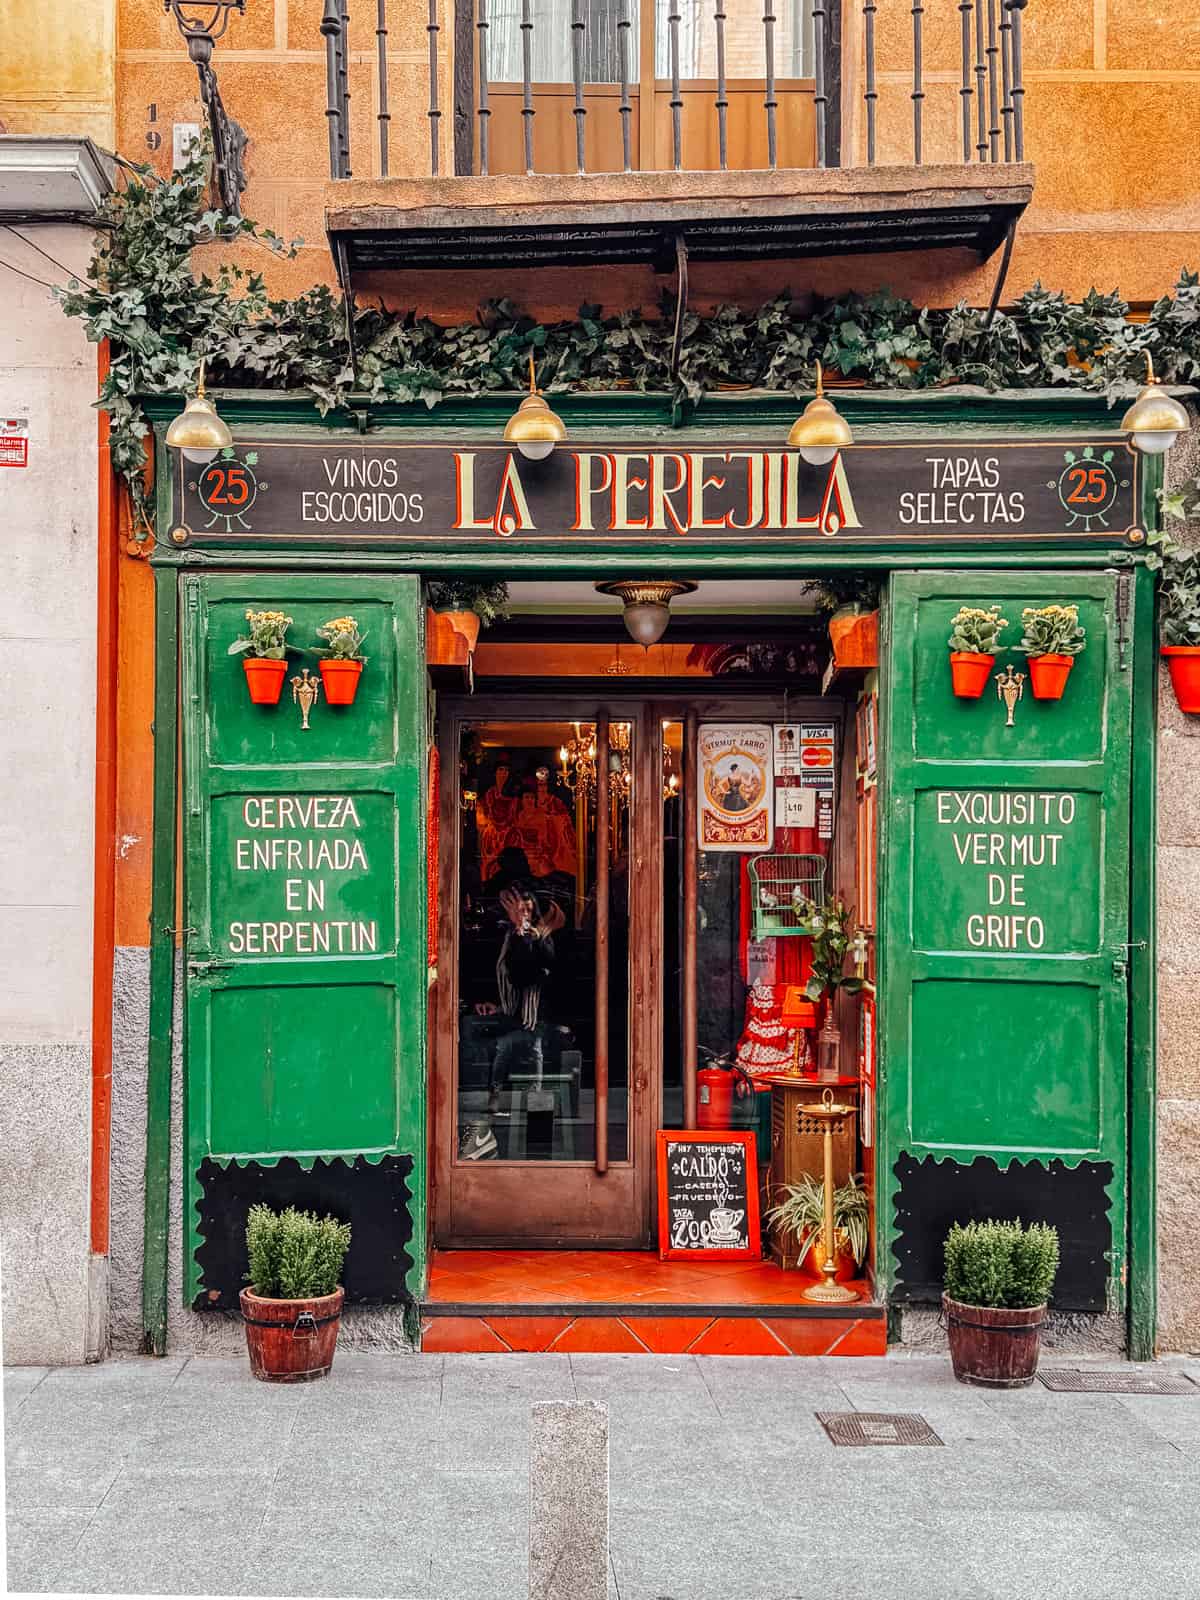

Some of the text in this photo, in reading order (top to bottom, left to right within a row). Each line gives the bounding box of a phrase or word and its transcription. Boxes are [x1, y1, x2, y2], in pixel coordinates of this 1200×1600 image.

[207, 469, 249, 505] 25
[323, 458, 398, 488] VINOS
[926, 457, 1000, 489] TAPAS
[1066, 468, 1108, 504] 25
[302, 491, 424, 523] ESCOGIDOS
[451, 451, 865, 537] LA PEREJILA
[899, 491, 1025, 524] SELECTAS
[739, 739, 765, 750] ZARRO
[806, 729, 829, 738] VISA
[243, 797, 361, 829] CERVEZA
[937, 792, 1076, 825] EXQUISITO
[236, 839, 368, 870] ENFRIADA
[952, 833, 1064, 866] VERMUT
[286, 879, 325, 911] EN
[987, 874, 1026, 907] DE
[229, 921, 377, 953] SERPENTIN
[966, 914, 1045, 949] GRIFO
[680, 1156, 729, 1178] CALDO
